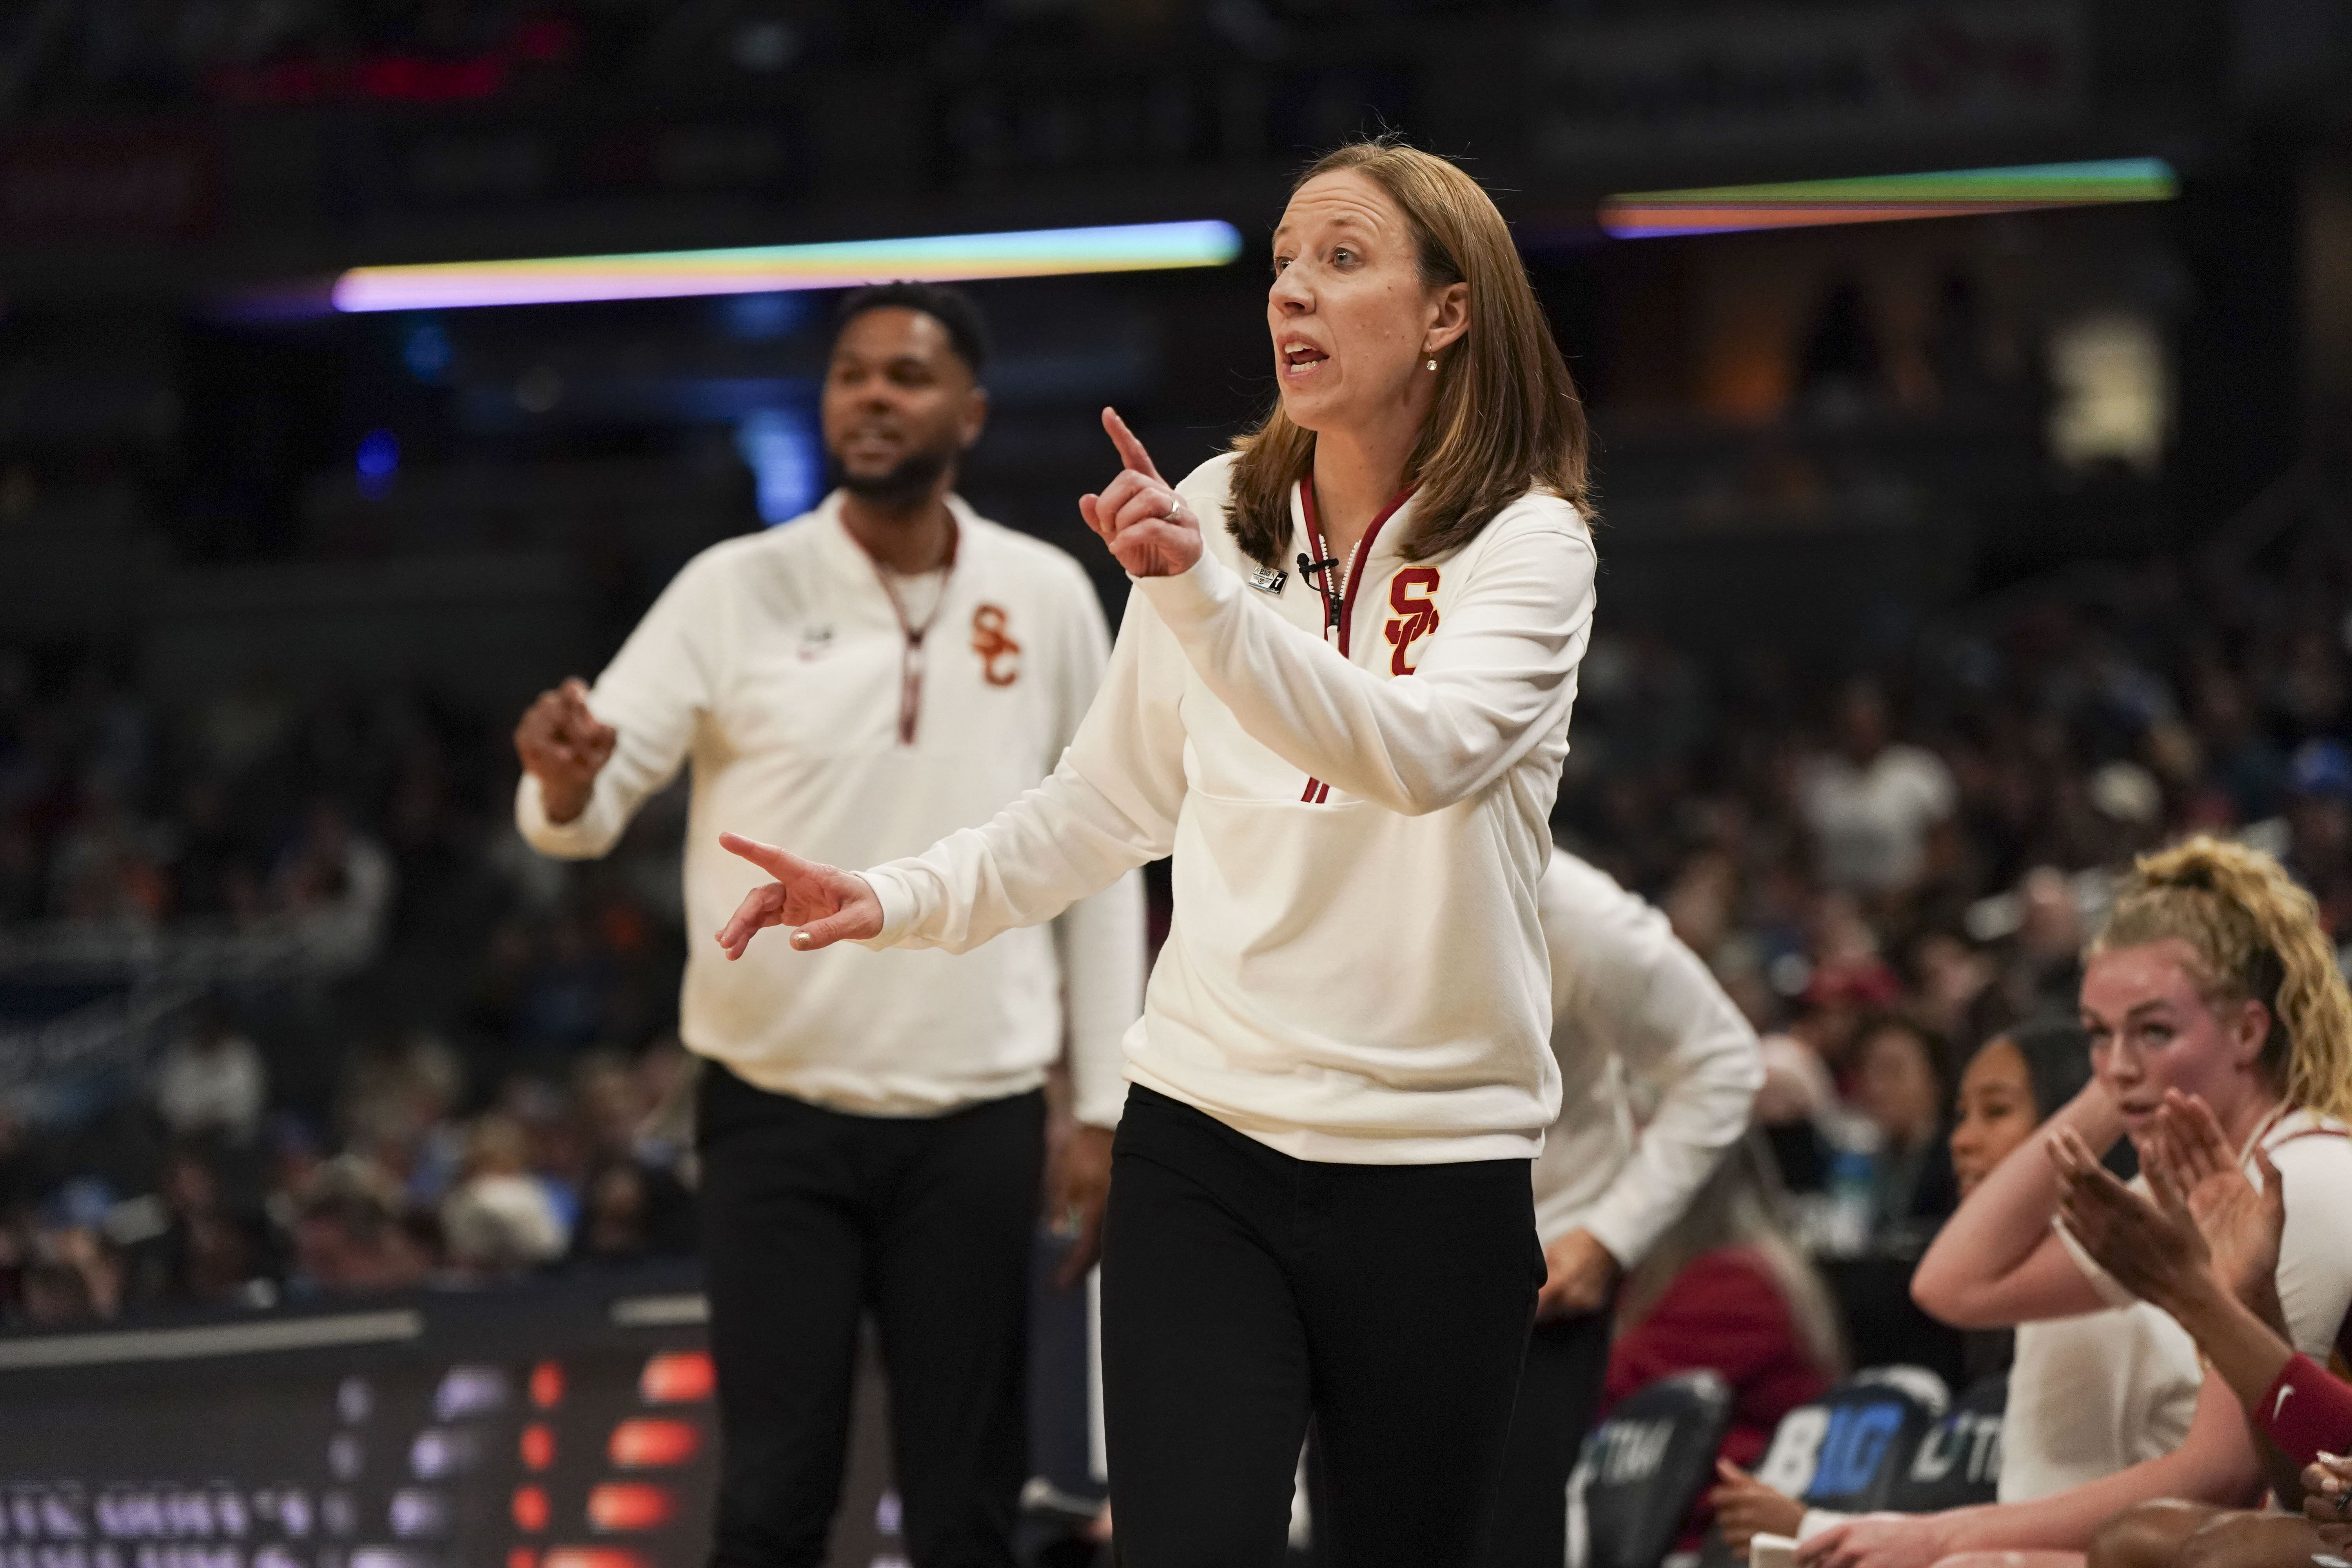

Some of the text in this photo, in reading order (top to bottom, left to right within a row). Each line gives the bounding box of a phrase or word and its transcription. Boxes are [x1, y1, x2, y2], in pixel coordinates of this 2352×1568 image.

[1274, 576, 1284, 588] 7
[1383, 566, 1441, 677] SC
[971, 604, 1020, 687] SC
